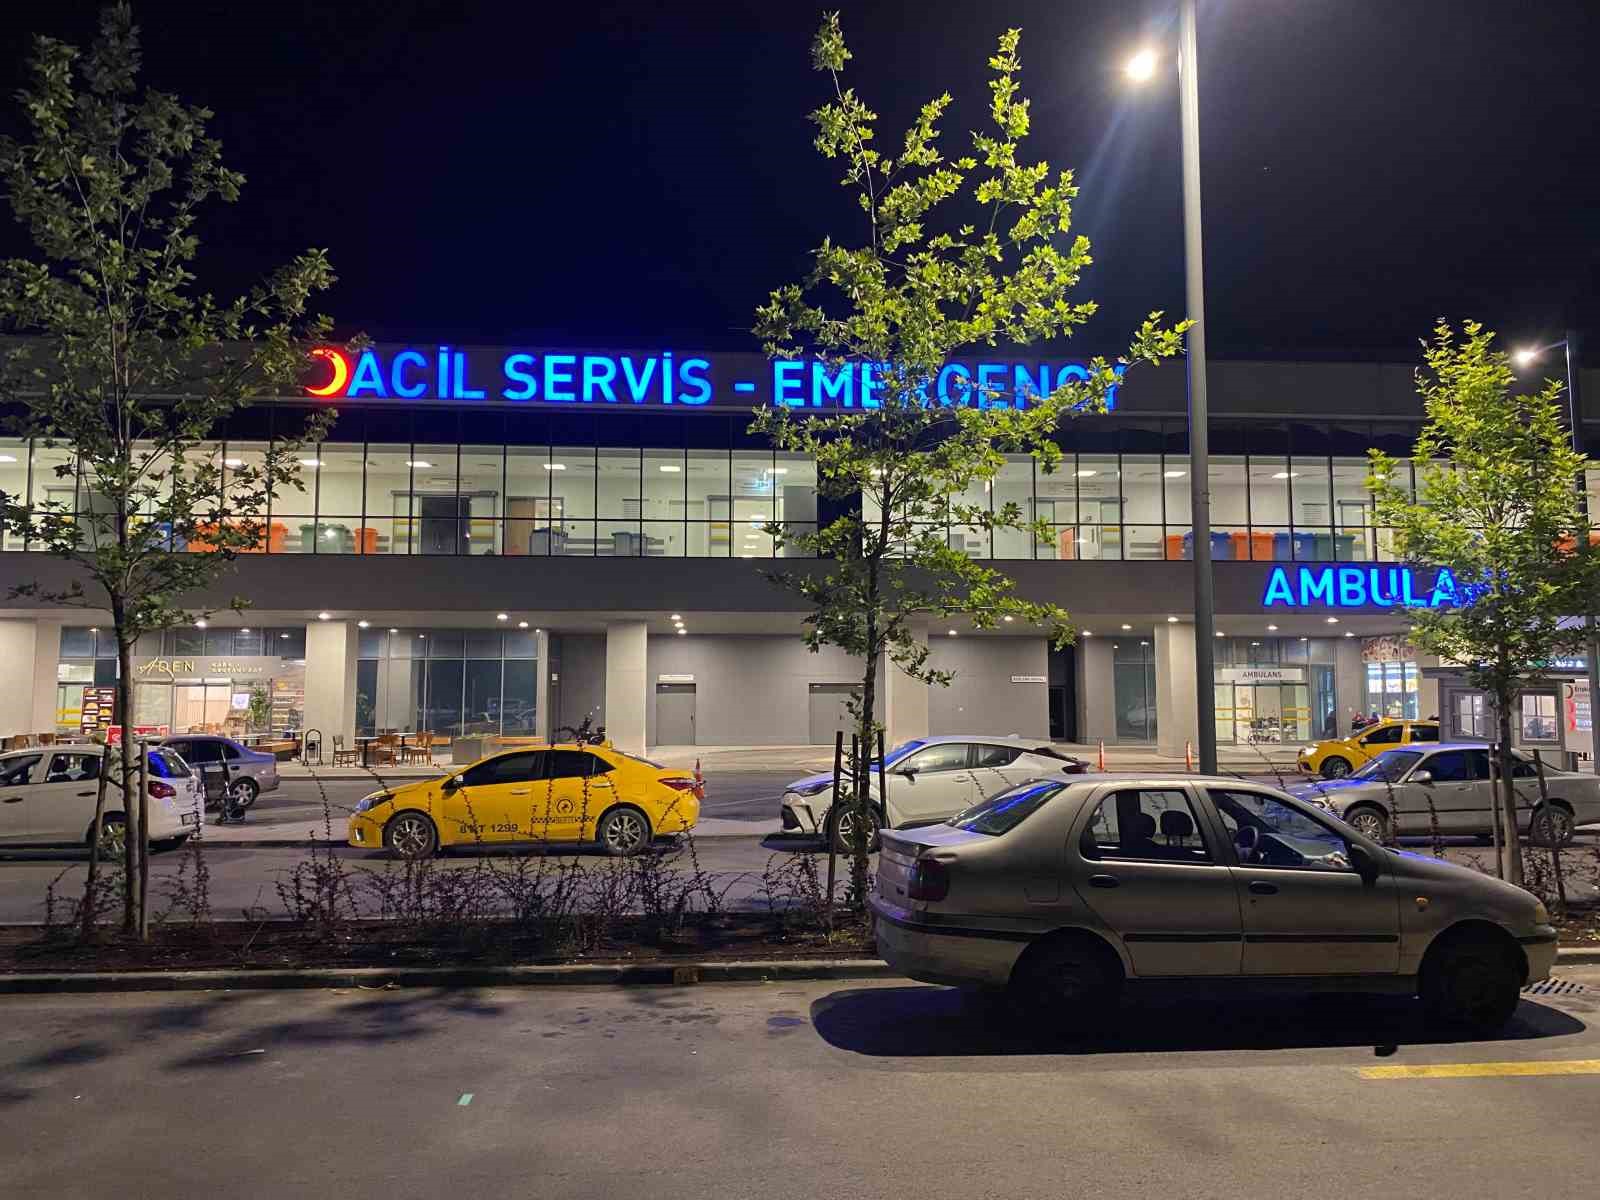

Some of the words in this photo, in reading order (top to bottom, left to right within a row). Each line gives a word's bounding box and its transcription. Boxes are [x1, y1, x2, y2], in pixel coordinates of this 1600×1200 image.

[346, 346, 485, 400] ACİL
[503, 352, 712, 405] SERVİS
[1264, 567, 1518, 608] AMBULA
[491, 823, 519, 833] 1299
